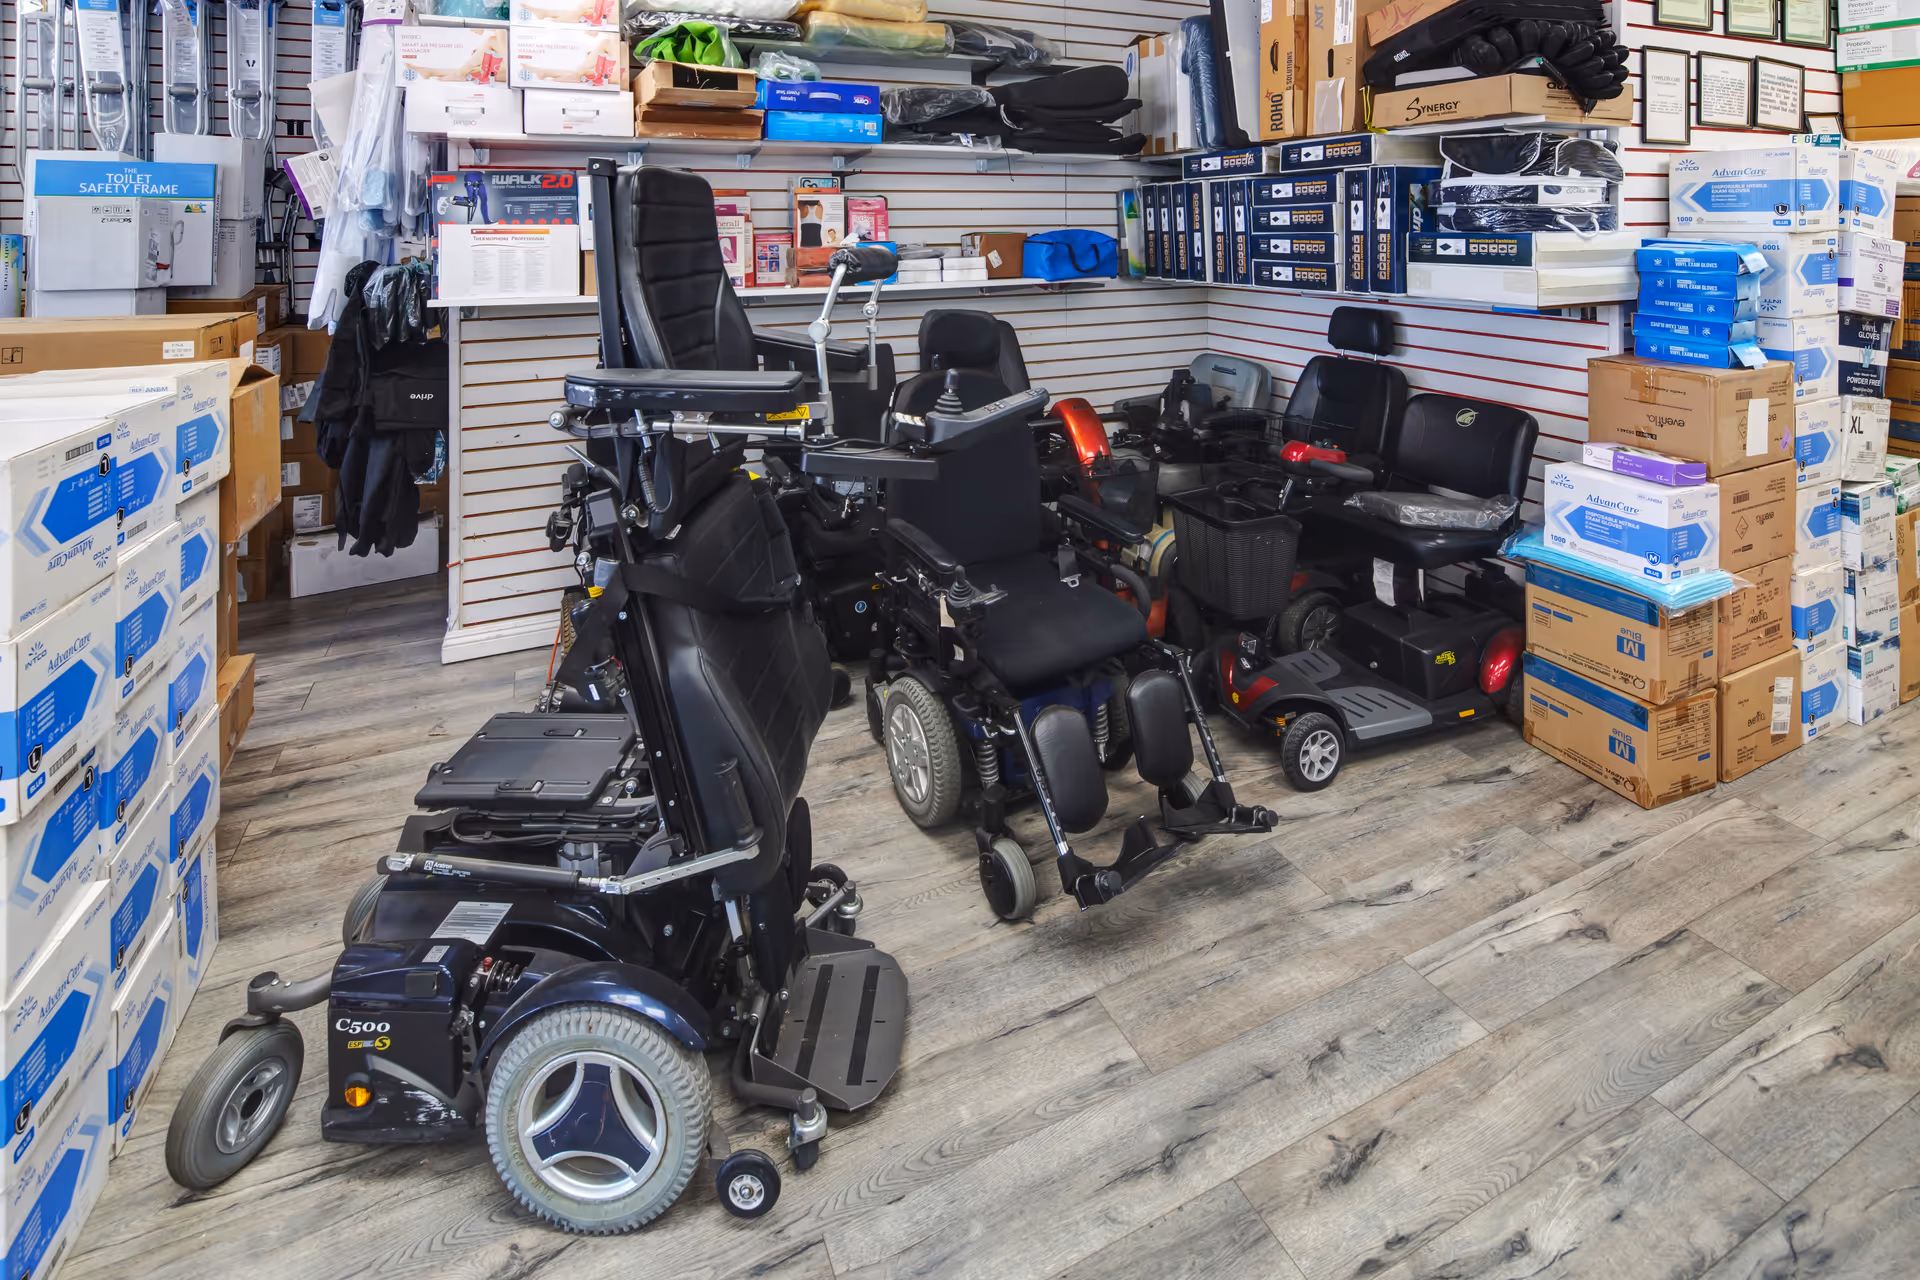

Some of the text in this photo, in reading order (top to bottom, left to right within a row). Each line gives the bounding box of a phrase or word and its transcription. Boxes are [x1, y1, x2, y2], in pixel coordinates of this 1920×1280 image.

[1314, 4, 1324, 30] JAY
[1271, 93, 1283, 131] ROHO
[106, 173, 152, 184] TOILET
[1711, 167, 1768, 177] AdvanCare
[79, 183, 179, 195] SAFETY FRAME
[542, 175, 574, 189] 2.0
[1858, 331, 1881, 341] GLOVES
[1861, 324, 1877, 333] VINYL
[1846, 376, 1881, 387] POWDER FREE
[410, 393, 434, 401] drive
[1648, 414, 1685, 428] evenflo
[1850, 416, 1864, 434] XL
[129, 433, 161, 453] AdvanCare
[1551, 480, 1574, 490] INTCO
[1586, 493, 1640, 515] AdvanCare
[1585, 510, 1640, 530] DISPOSABLE NITRILE
[1585, 515, 1623, 530] EXAM GLOVES
[1681, 509, 1708, 521] AdvanCare
[1550, 534, 1566, 544] 1000
[47, 536, 95, 572] AdvanCare
[93, 545, 112, 560] INTCO
[1649, 554, 1658, 563] M
[1646, 568, 1660, 578] BLUE
[138, 569, 167, 596] AdvanCare
[1620, 627, 1642, 641] Blue
[48, 632, 93, 674] AdvanCare
[1623, 638, 1639, 657] M
[24, 650, 48, 671] INTCO
[1611, 728, 1633, 745] Blue
[1614, 740, 1630, 759] M
[29, 777, 44, 794] BLUE
[1604, 767, 1636, 792] Queen
[38, 953, 88, 1024] AdvanCare
[335, 1018, 391, 1035] C500
